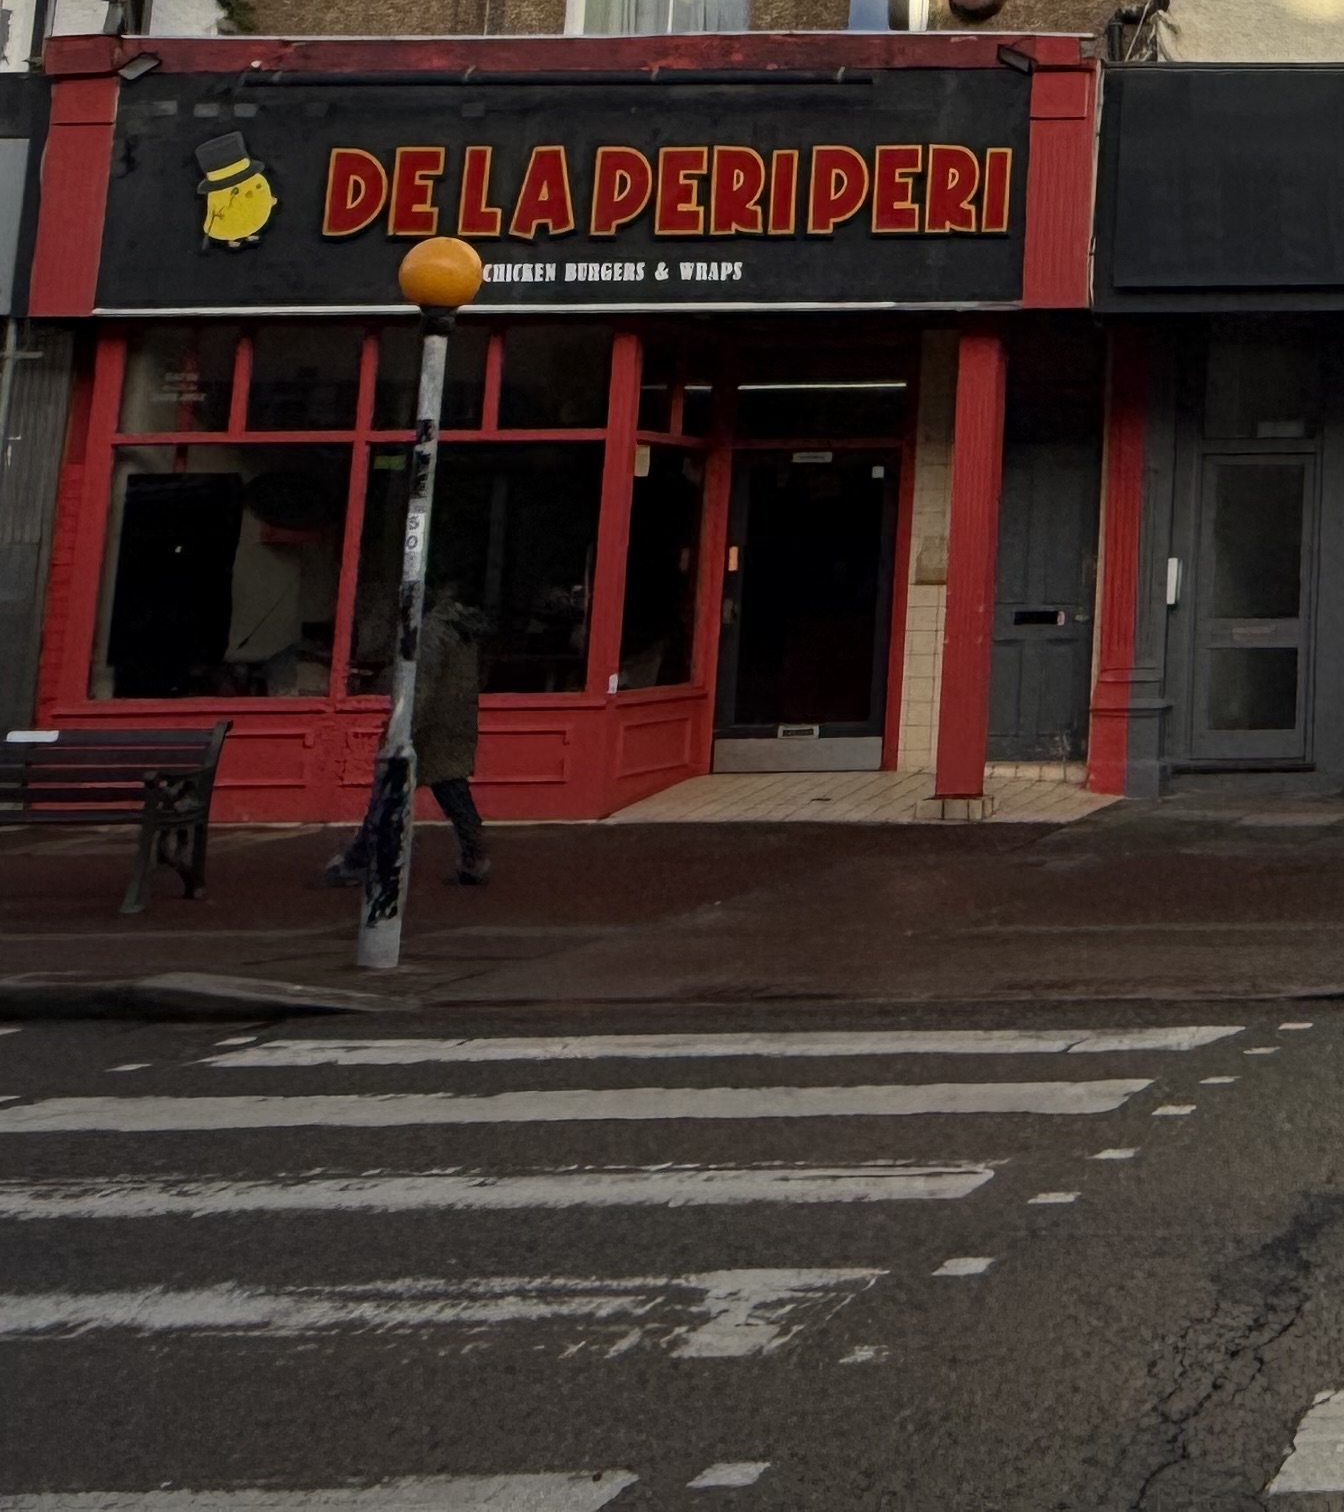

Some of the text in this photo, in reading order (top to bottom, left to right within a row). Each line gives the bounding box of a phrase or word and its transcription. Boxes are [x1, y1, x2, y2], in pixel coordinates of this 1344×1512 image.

[322, 146, 446, 236] DE
[458, 145, 575, 239] LA
[482, 261, 744, 283] CHICKEN BURGERS & WRAPS
